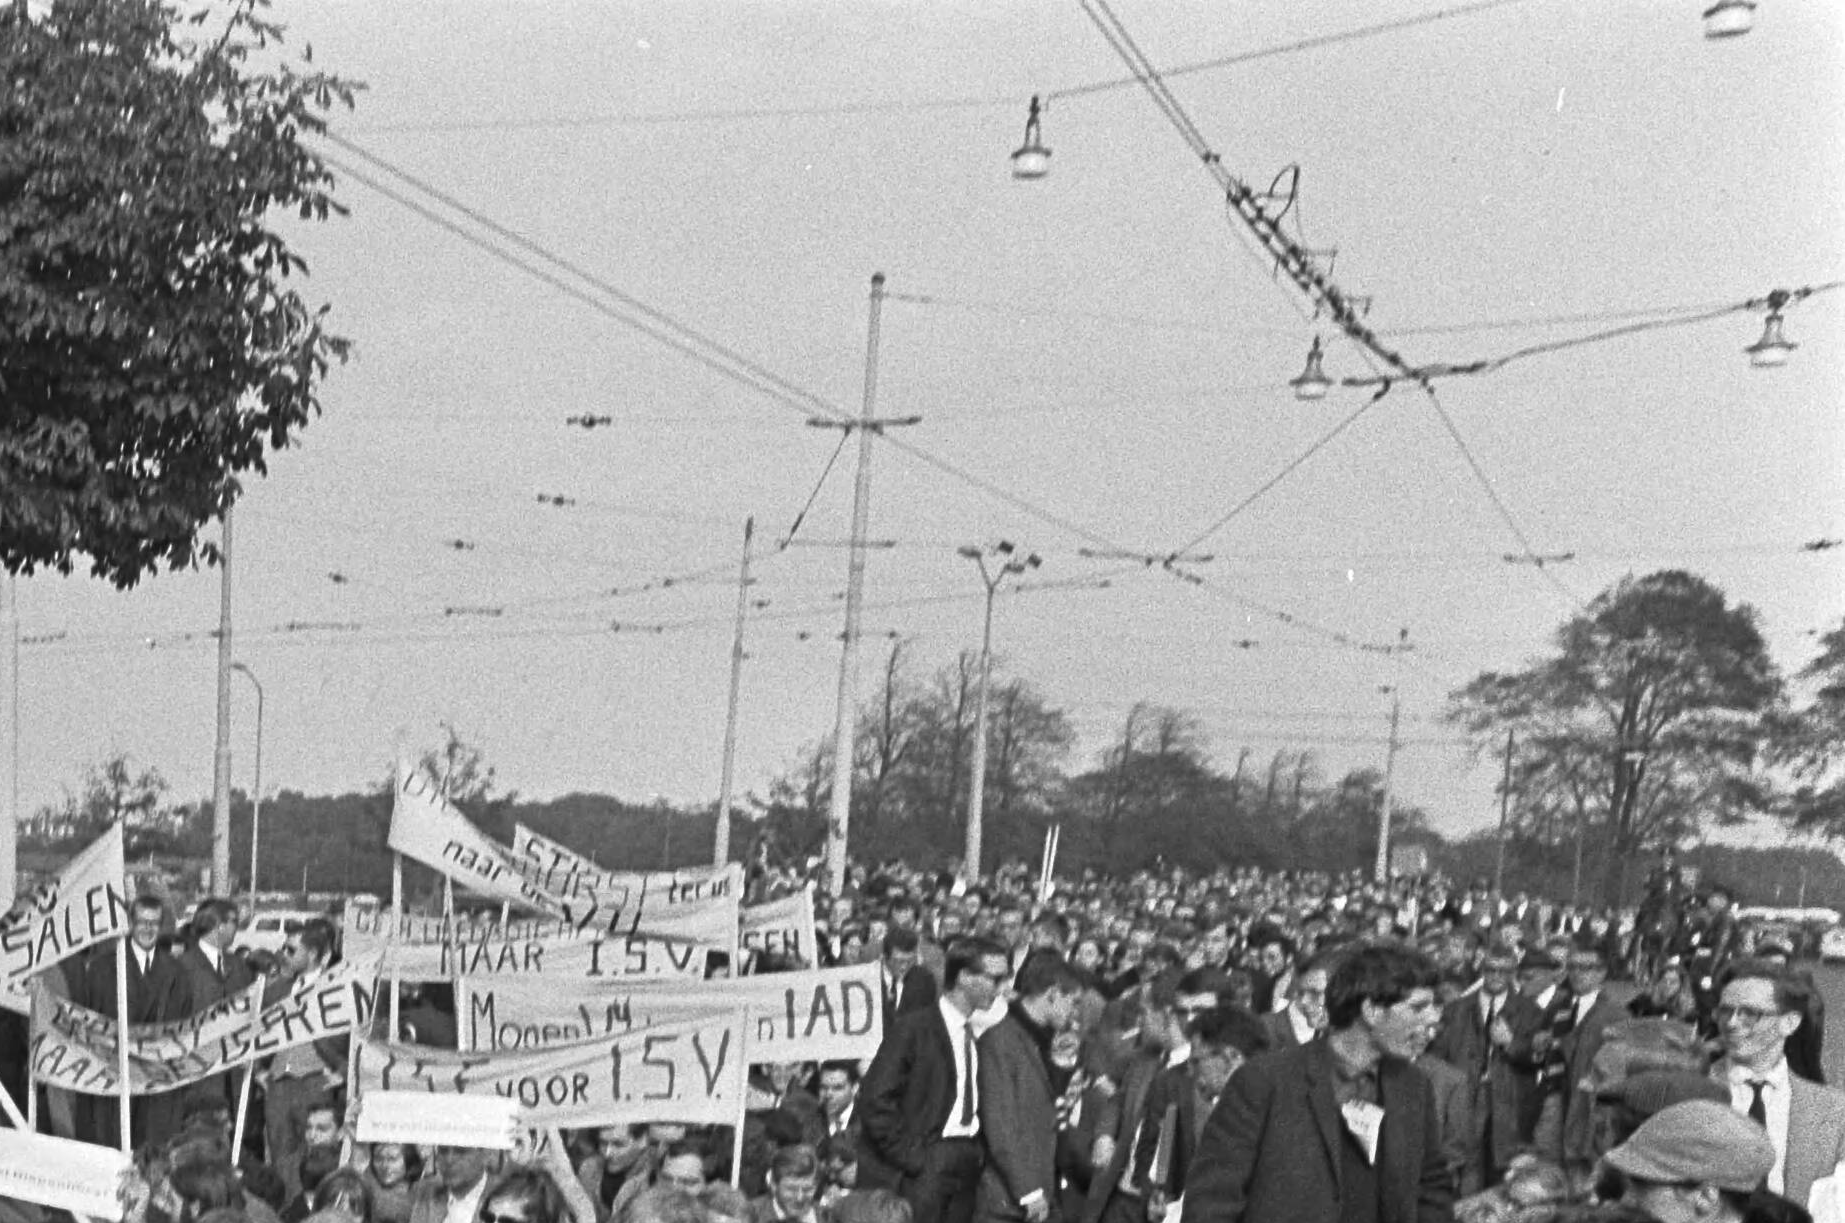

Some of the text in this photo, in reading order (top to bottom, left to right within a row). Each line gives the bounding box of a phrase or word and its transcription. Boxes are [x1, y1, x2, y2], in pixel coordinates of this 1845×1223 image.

[442, 840, 513, 883] naar
[439, 941, 544, 977] MAAR
[784, 980, 875, 1041] IAD
